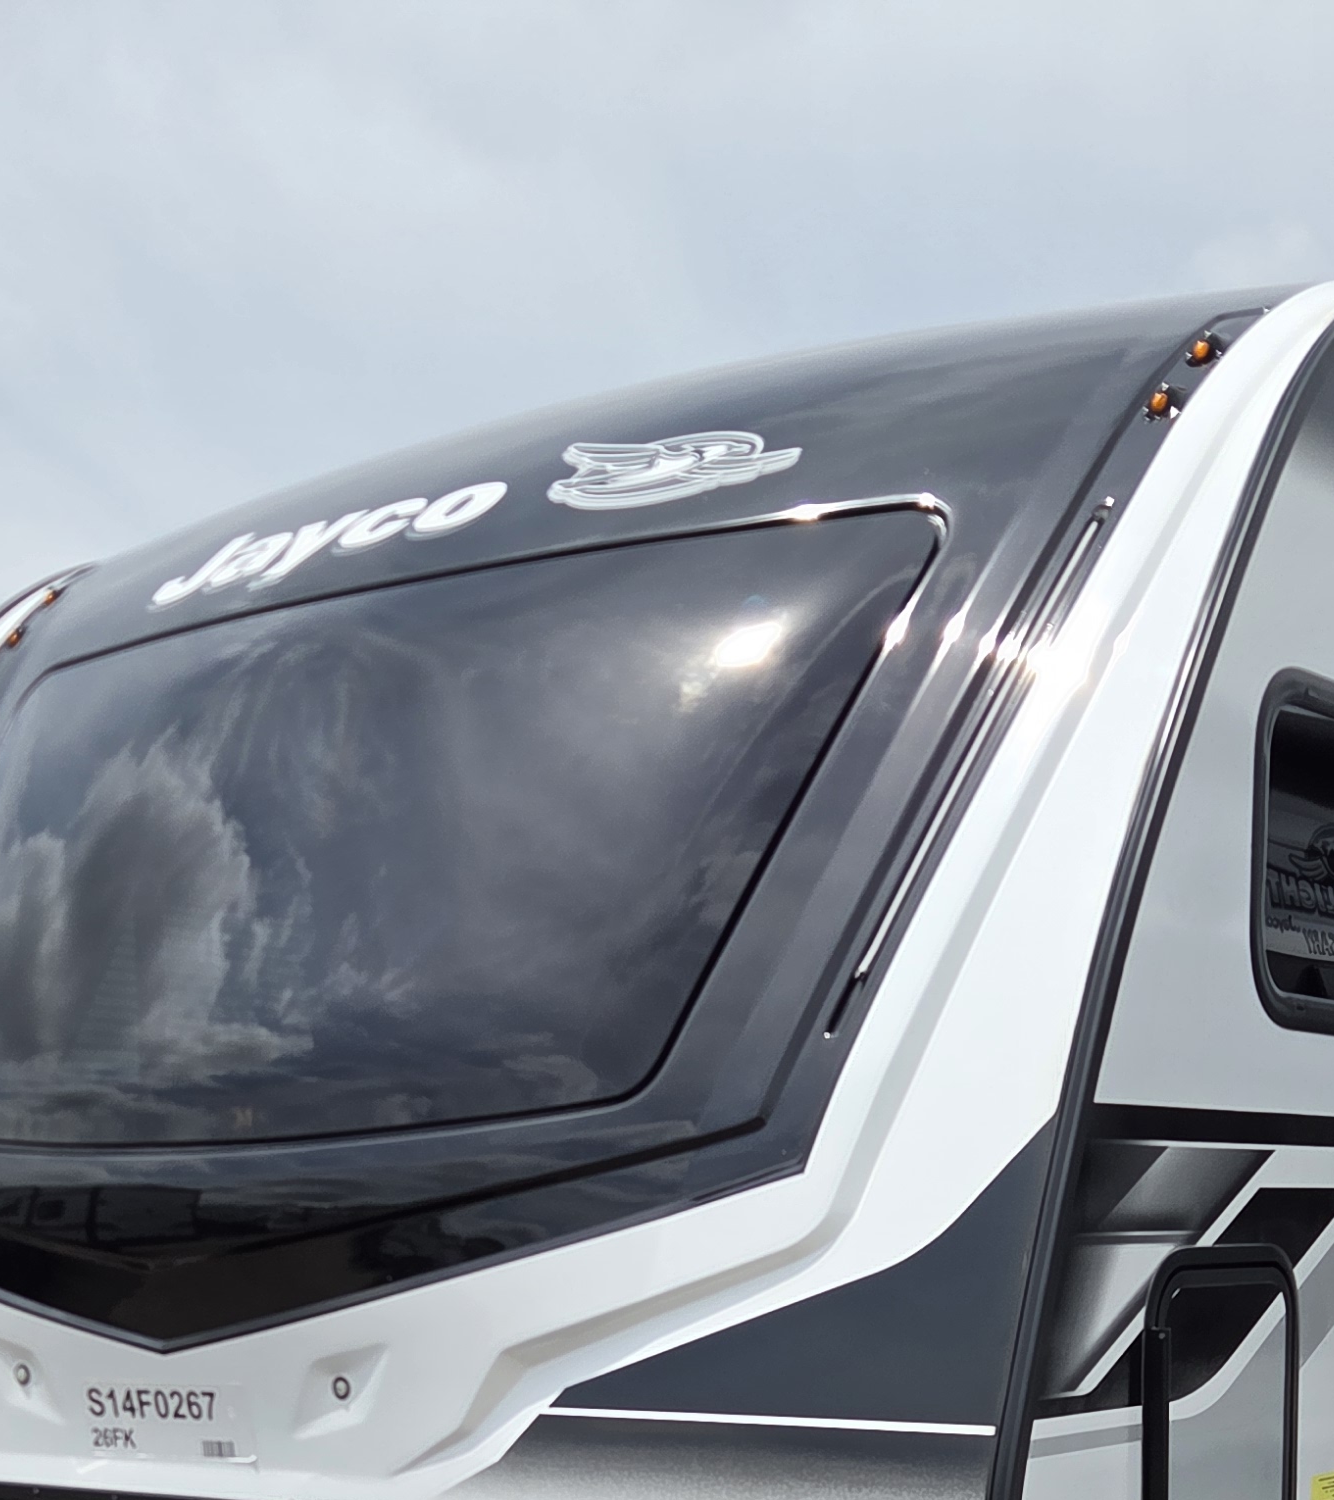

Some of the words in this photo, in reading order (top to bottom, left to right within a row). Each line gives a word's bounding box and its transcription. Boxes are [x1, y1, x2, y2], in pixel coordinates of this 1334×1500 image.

[151, 481, 508, 607] Jayco
[87, 1387, 215, 1420] S14F0267
[92, 1428, 136, 1448] 26FK
